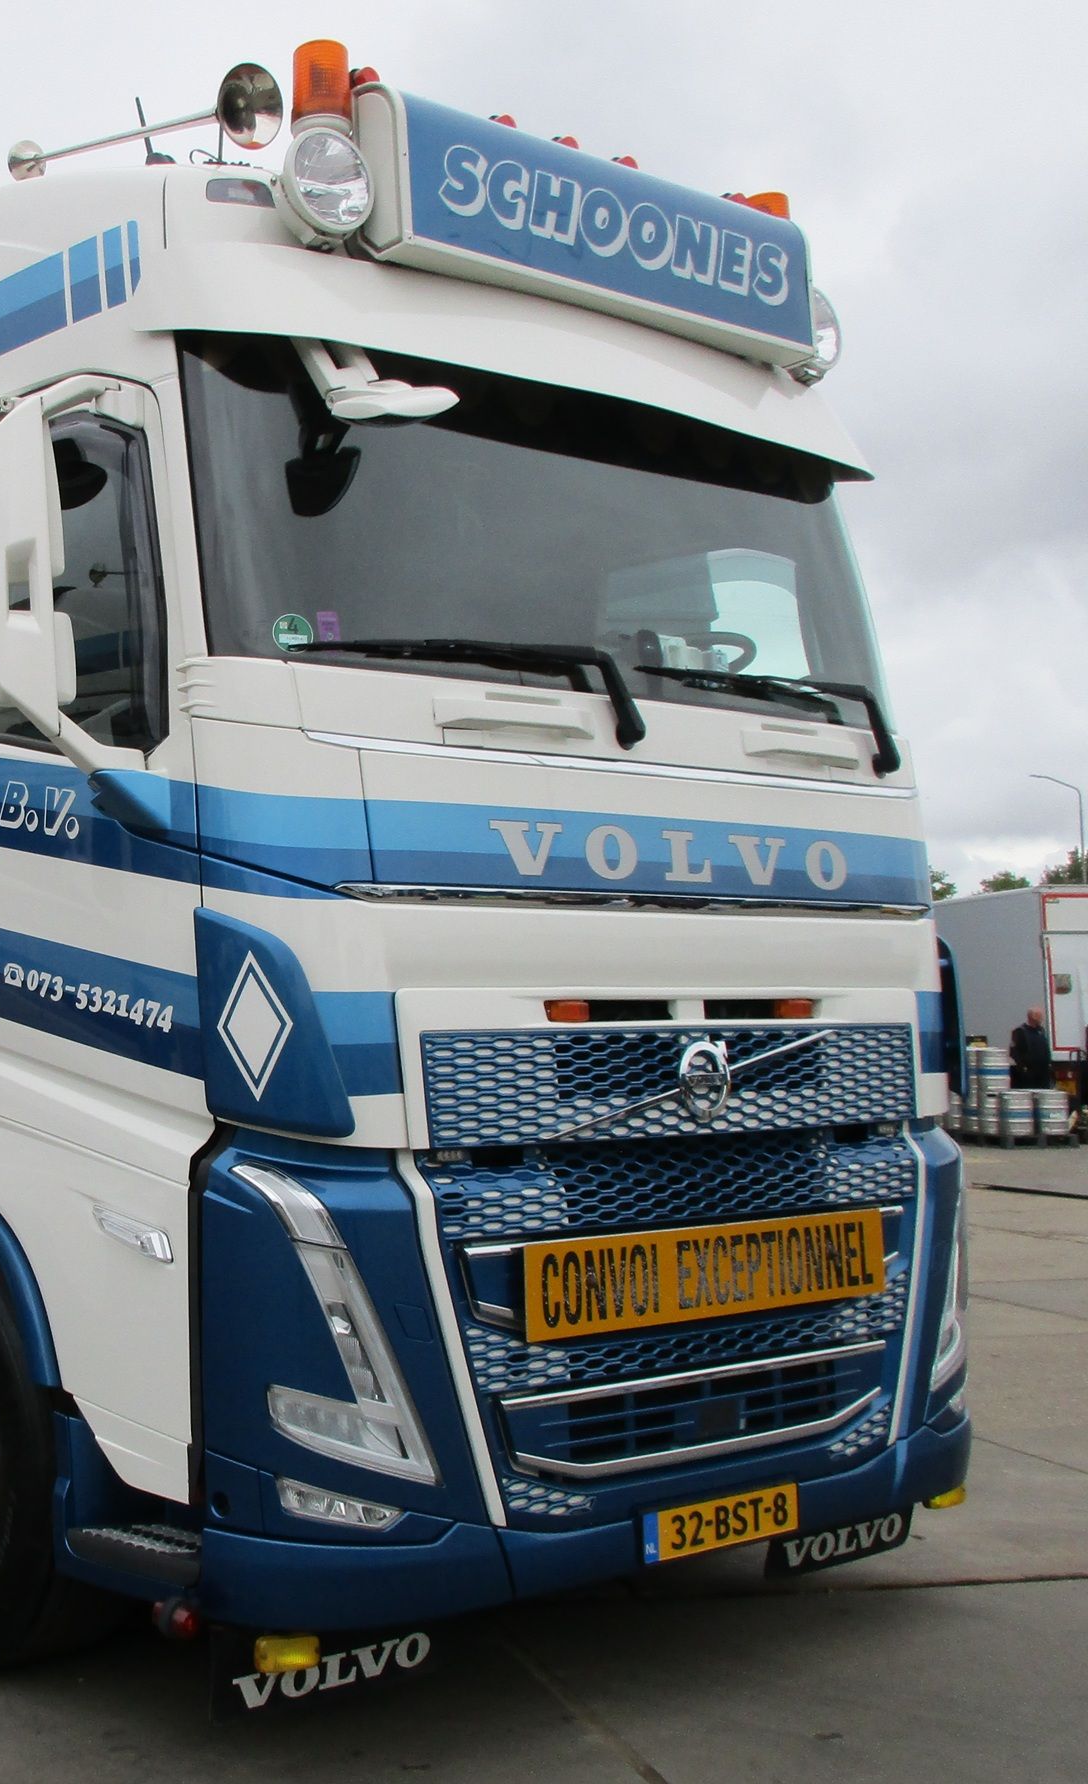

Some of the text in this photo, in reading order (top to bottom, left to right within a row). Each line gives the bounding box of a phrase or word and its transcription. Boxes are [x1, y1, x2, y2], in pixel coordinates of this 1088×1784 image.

[438, 144, 790, 306] SCHOONES
[0, 781, 80, 840] B.V.
[489, 819, 848, 891] VOLVO
[26, 970, 174, 1033] 073-5321474
[542, 1221, 873, 1328] CONVOI EXCEPTIONNEL
[645, 1543, 657, 1555] NL
[671, 1492, 788, 1550] 32-BST-8
[783, 1512, 903, 1569] VOLVO
